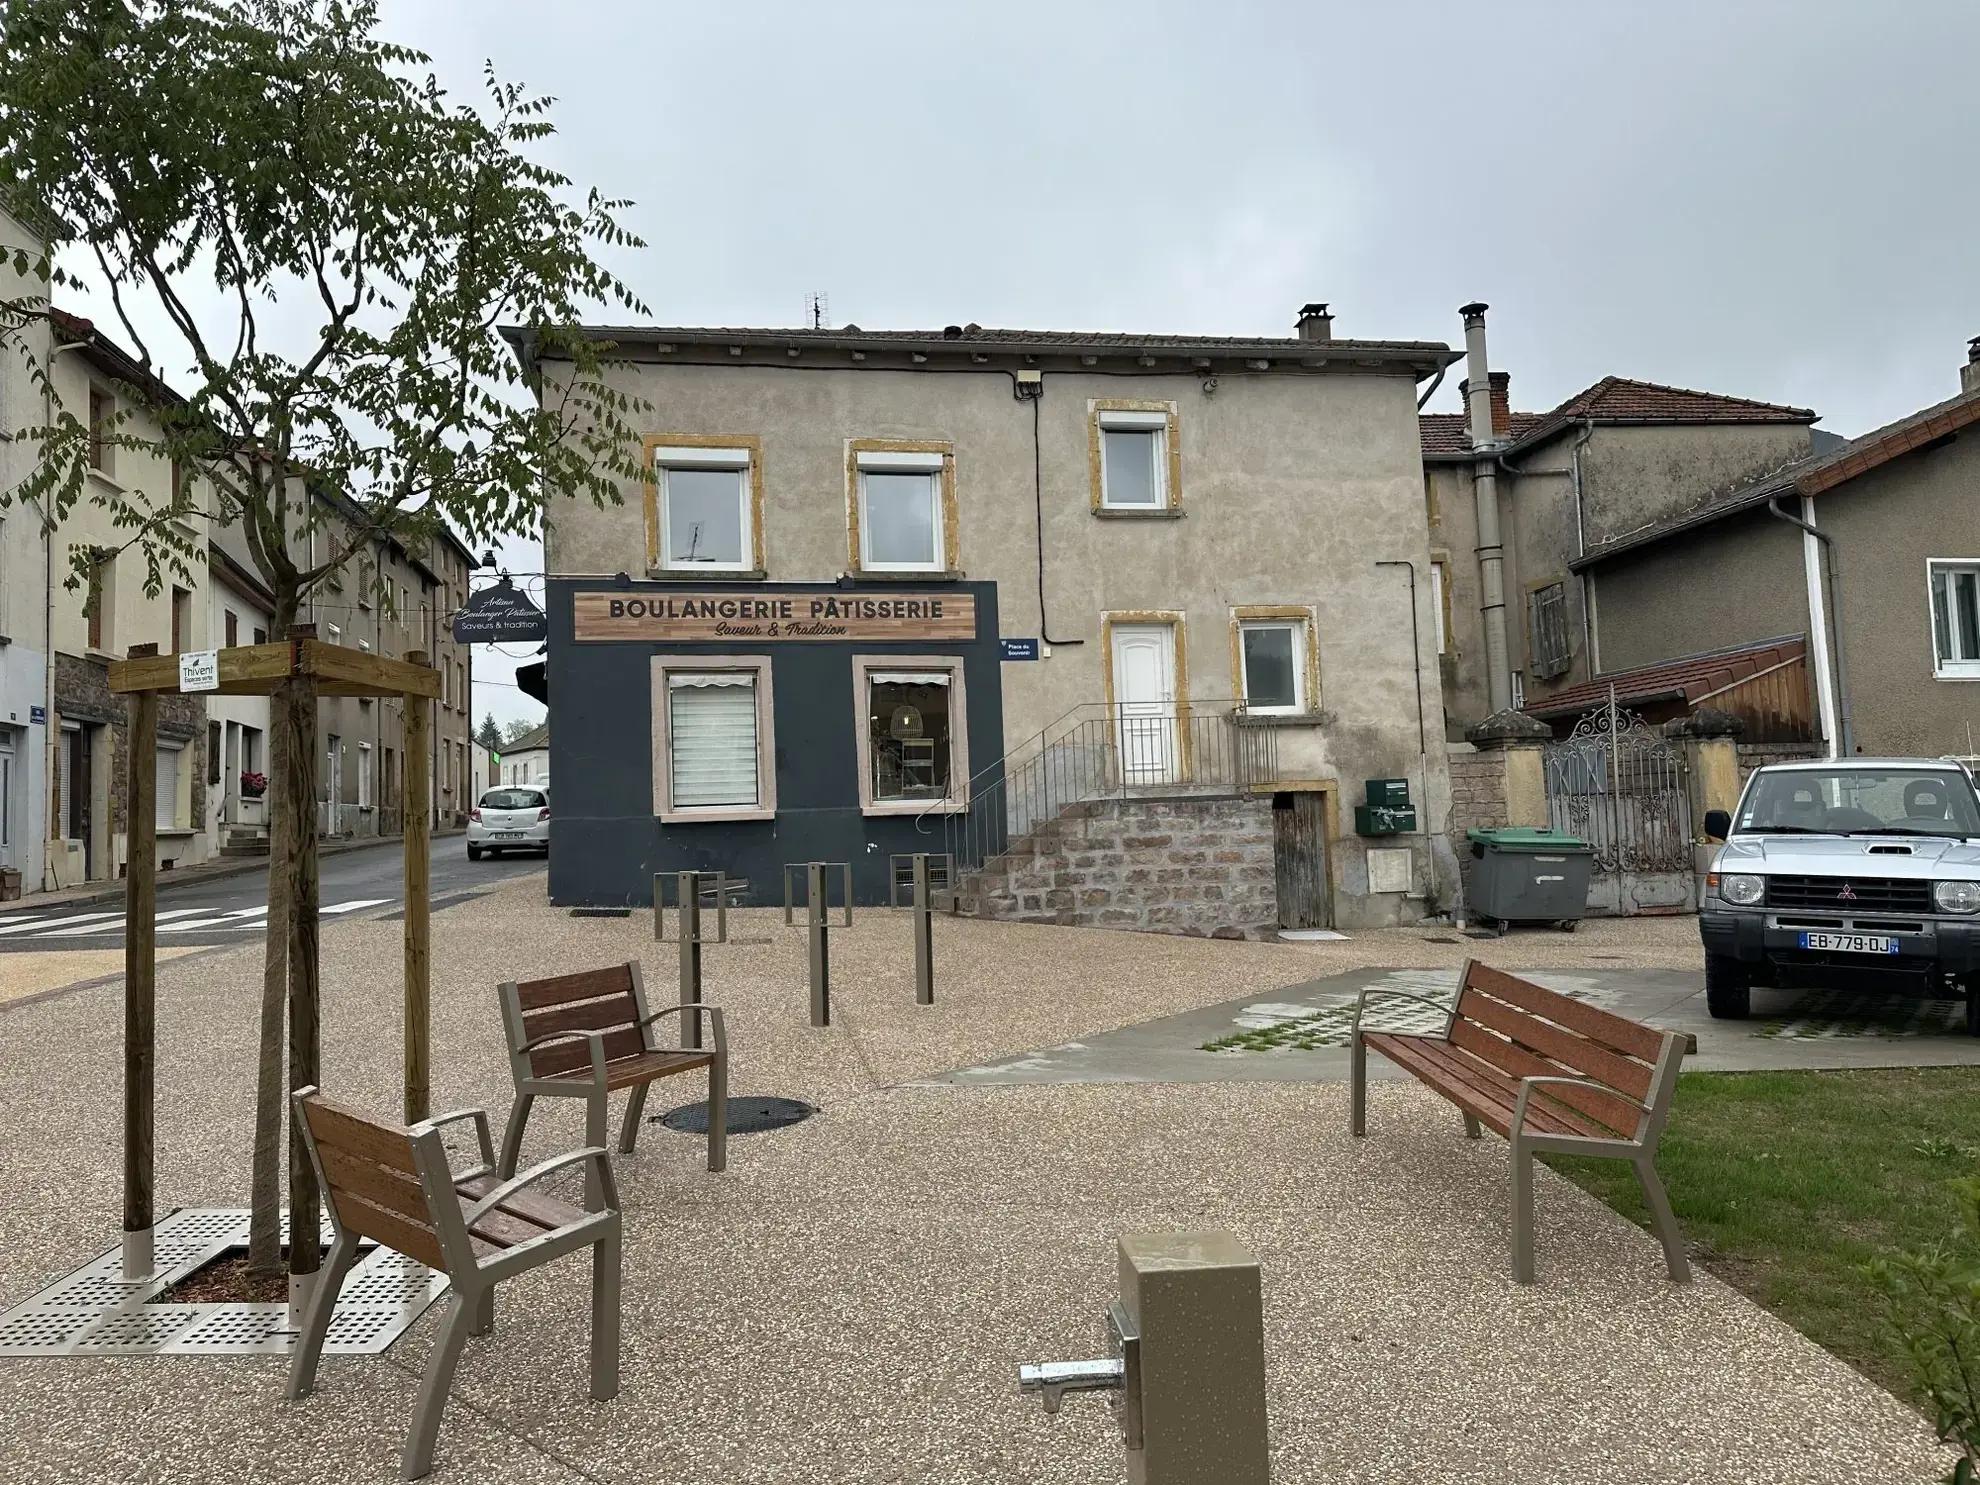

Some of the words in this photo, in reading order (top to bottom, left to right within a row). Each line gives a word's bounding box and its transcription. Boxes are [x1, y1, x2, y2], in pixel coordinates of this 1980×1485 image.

[481, 596, 515, 608] Artisan
[610, 599, 792, 619] BOULANGERIE
[810, 596, 943, 619] PÂTISSERIE
[456, 608, 503, 621] Boulanger
[461, 622, 494, 630] Saveurs
[495, 621, 502, 629] &
[504, 621, 539, 629] tradition
[714, 621, 762, 637] Saveur
[767, 622, 779, 637] &
[784, 621, 847, 637] Tradition
[183, 665, 213, 676] Thivent
[1809, 934, 1889, 952] EB-779-DJ
